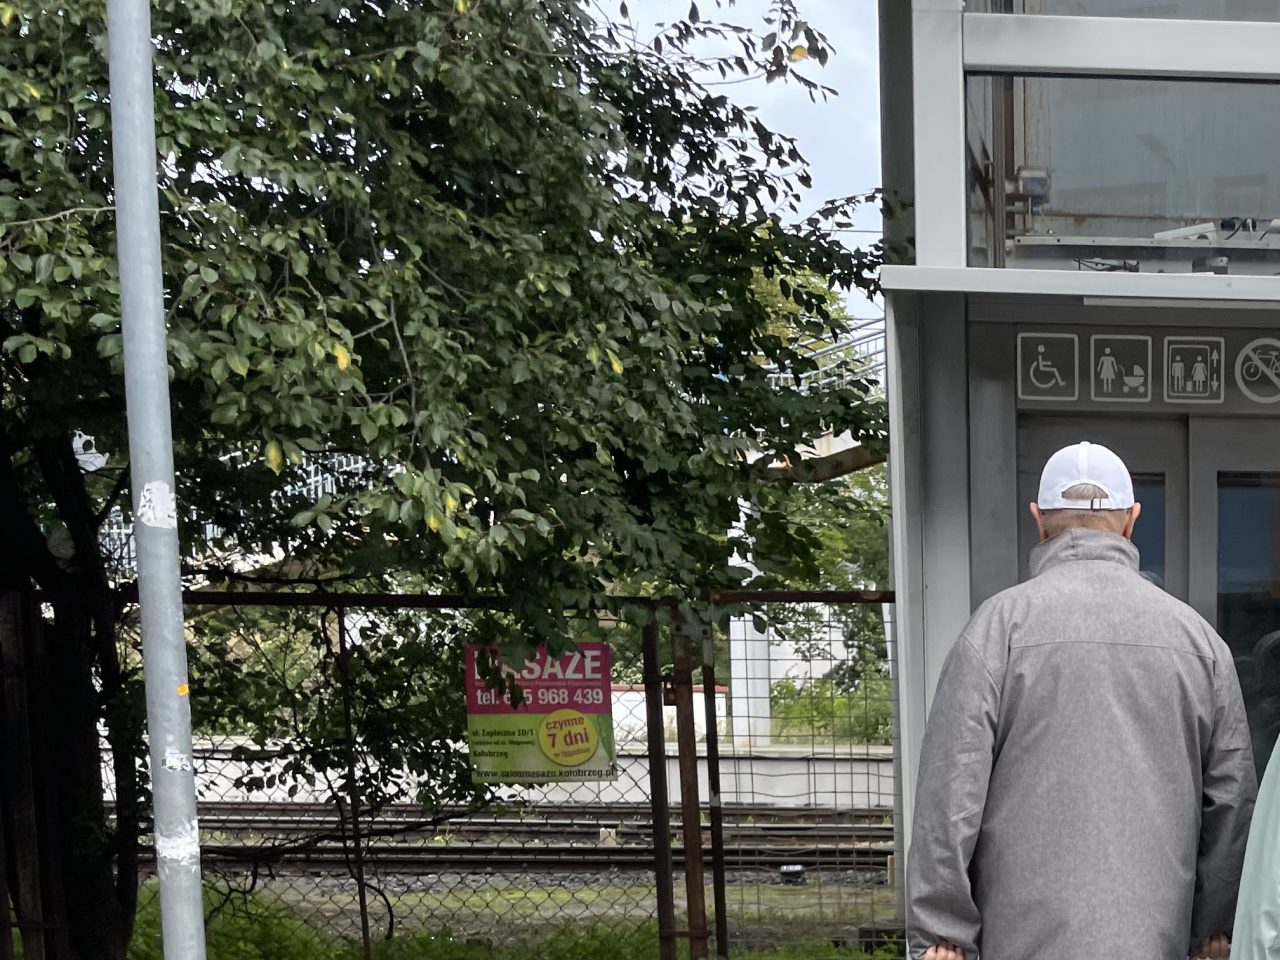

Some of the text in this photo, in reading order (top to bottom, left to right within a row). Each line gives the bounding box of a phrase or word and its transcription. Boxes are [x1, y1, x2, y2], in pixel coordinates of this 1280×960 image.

[476, 688, 603, 705] tel. 65 968 439
[545, 716, 585, 731] czynne
[547, 733, 557, 748] 7
[563, 728, 589, 746] dni
